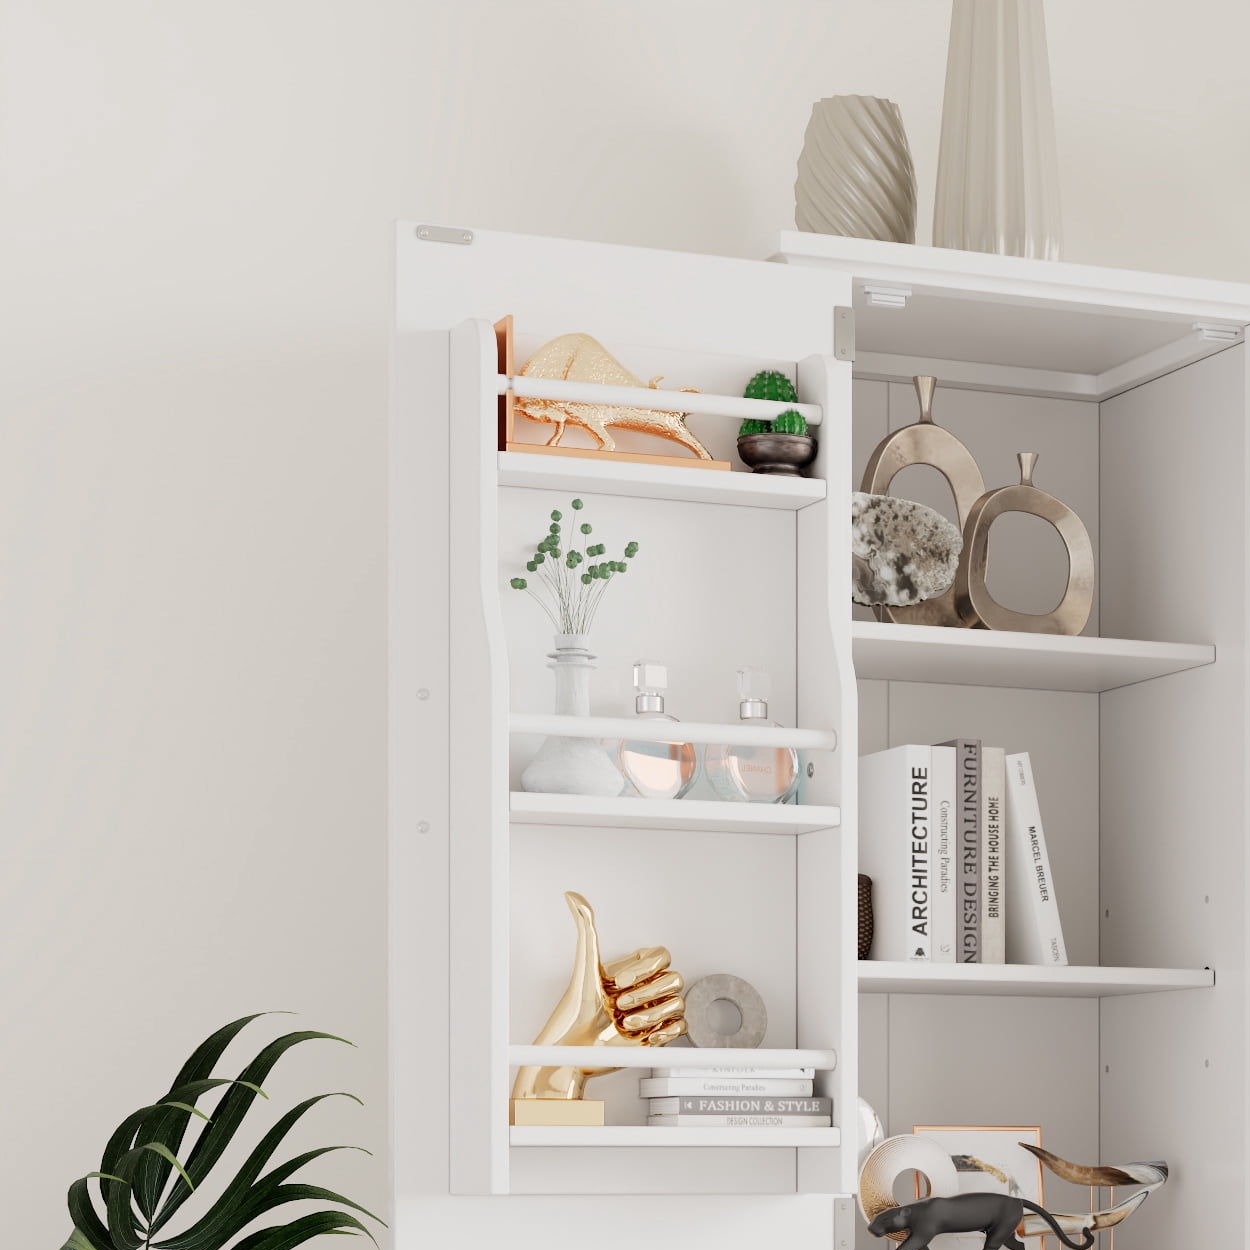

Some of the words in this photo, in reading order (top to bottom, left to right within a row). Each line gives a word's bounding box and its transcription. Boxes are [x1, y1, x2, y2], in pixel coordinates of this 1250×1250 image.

[937, 800, 950, 855] Constructing
[963, 743, 977, 874] FURNITURE
[988, 796, 999, 821] HOME
[911, 766, 928, 936] ARCHITECTURE
[988, 823, 999, 853] HOUSE
[988, 856, 999, 873] THE
[1028, 826, 1041, 864] MARCEL
[1035, 864, 1049, 902] BREUER
[988, 875, 999, 918] BRINGING
[963, 882, 977, 963] DESIGN
[699, 1100, 760, 1112] FASHION
[763, 1101, 775, 1112] &
[778, 1101, 820, 1112] STYLE
